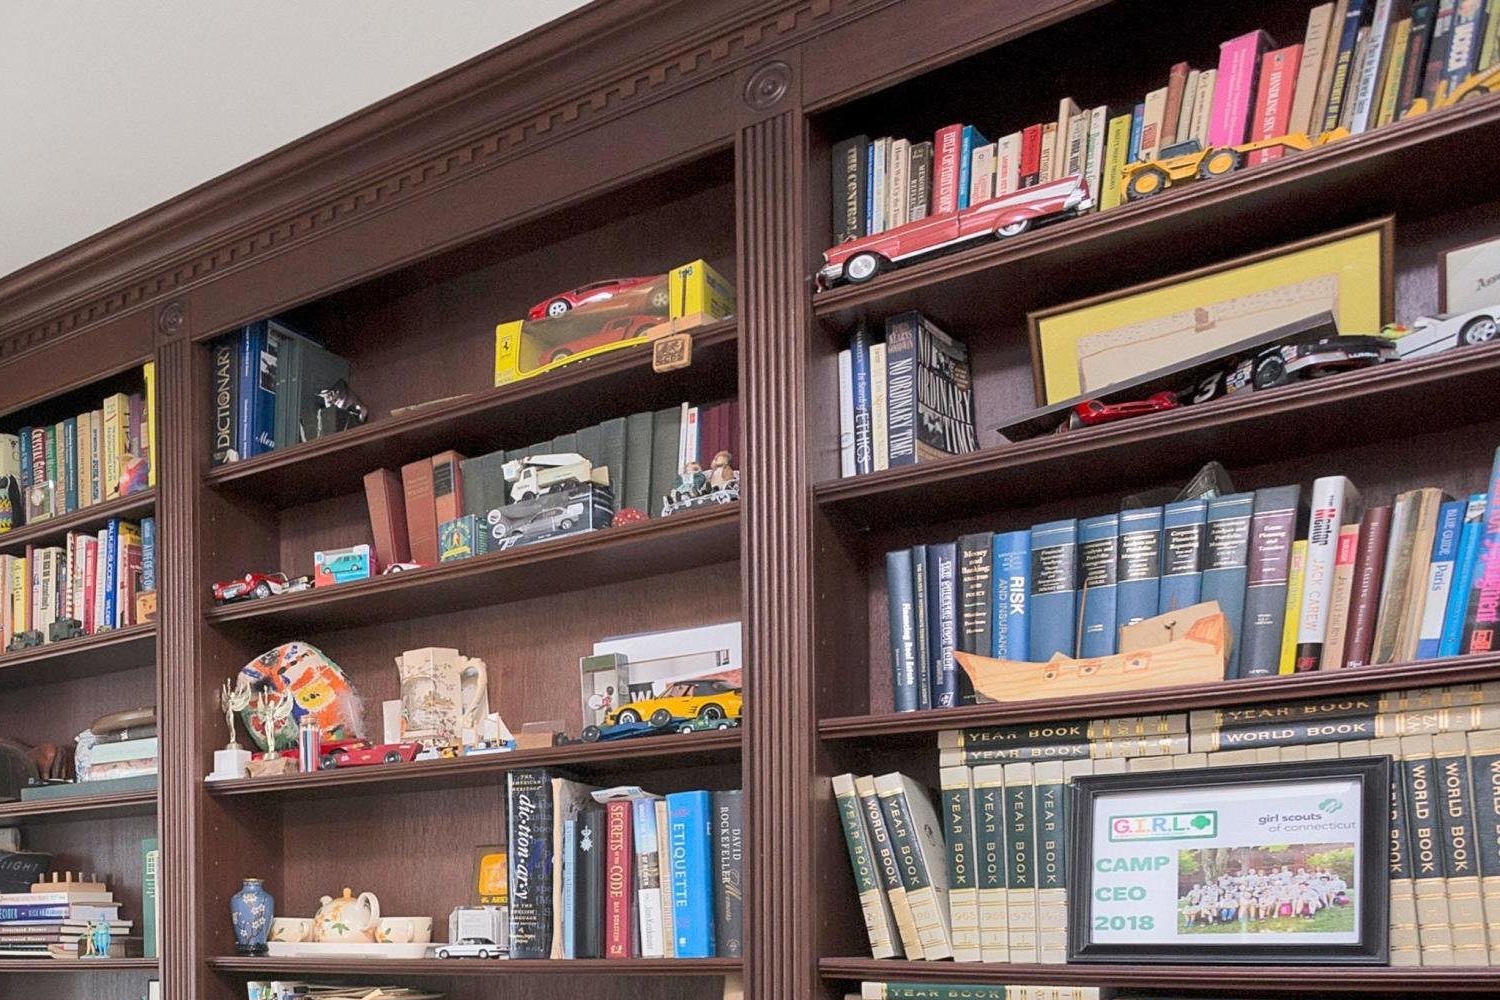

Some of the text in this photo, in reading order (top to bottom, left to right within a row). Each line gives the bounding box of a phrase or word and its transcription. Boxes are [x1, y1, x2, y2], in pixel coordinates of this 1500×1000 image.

[889, 357, 913, 376] NO
[217, 344, 230, 449] DICTIONARY
[889, 376, 913, 430] ORDINARY
[917, 363, 972, 425] ORDINARY
[855, 412, 872, 464] ETHICS
[889, 431, 913, 459] TIME
[963, 550, 988, 559] Money
[1438, 528, 1454, 556] GUIDE
[1305, 507, 1337, 632] Mentor JACK CAREW
[1431, 564, 1448, 592] Paris
[998, 579, 1008, 601] AND
[1009, 576, 1025, 615] RISK
[902, 603, 914, 641] Financing
[905, 660, 915, 686] Estate
[1028, 726, 1081, 737] BOOK
[1227, 722, 1367, 742] WORLD BOOK
[970, 745, 1083, 760] YEAR BOOK
[610, 805, 624, 851] SECRETS
[1113, 816, 1191, 835] G.I.R.L.
[1258, 812, 1322, 826] girl scouts
[1269, 821, 1357, 833] of connecticut
[1411, 764, 1435, 873] WORLD BOOK
[1445, 762, 1468, 872] WORLD BOOK
[720, 806, 731, 884] ROCKEFELLER
[731, 828, 741, 861] DAVID
[843, 799, 871, 887] YEAR BOOK
[867, 799, 897, 886] WORLD BOOK
[888, 799, 920, 886] YEAR BOOK
[951, 794, 967, 885] YEAR BOOK
[984, 792, 997, 885] YEAR BOOK
[1014, 791, 1026, 884] YEAR BOOK
[1044, 790, 1056, 884] YEAR BOOK
[610, 865, 623, 898] CODE
[673, 822, 688, 908] ETIQUETTE
[1095, 856, 1170, 873] CAMP
[1095, 886, 1146, 901] CEO
[1094, 915, 1155, 931] 2018
[890, 988, 1000, 999] YEAR BOOK
